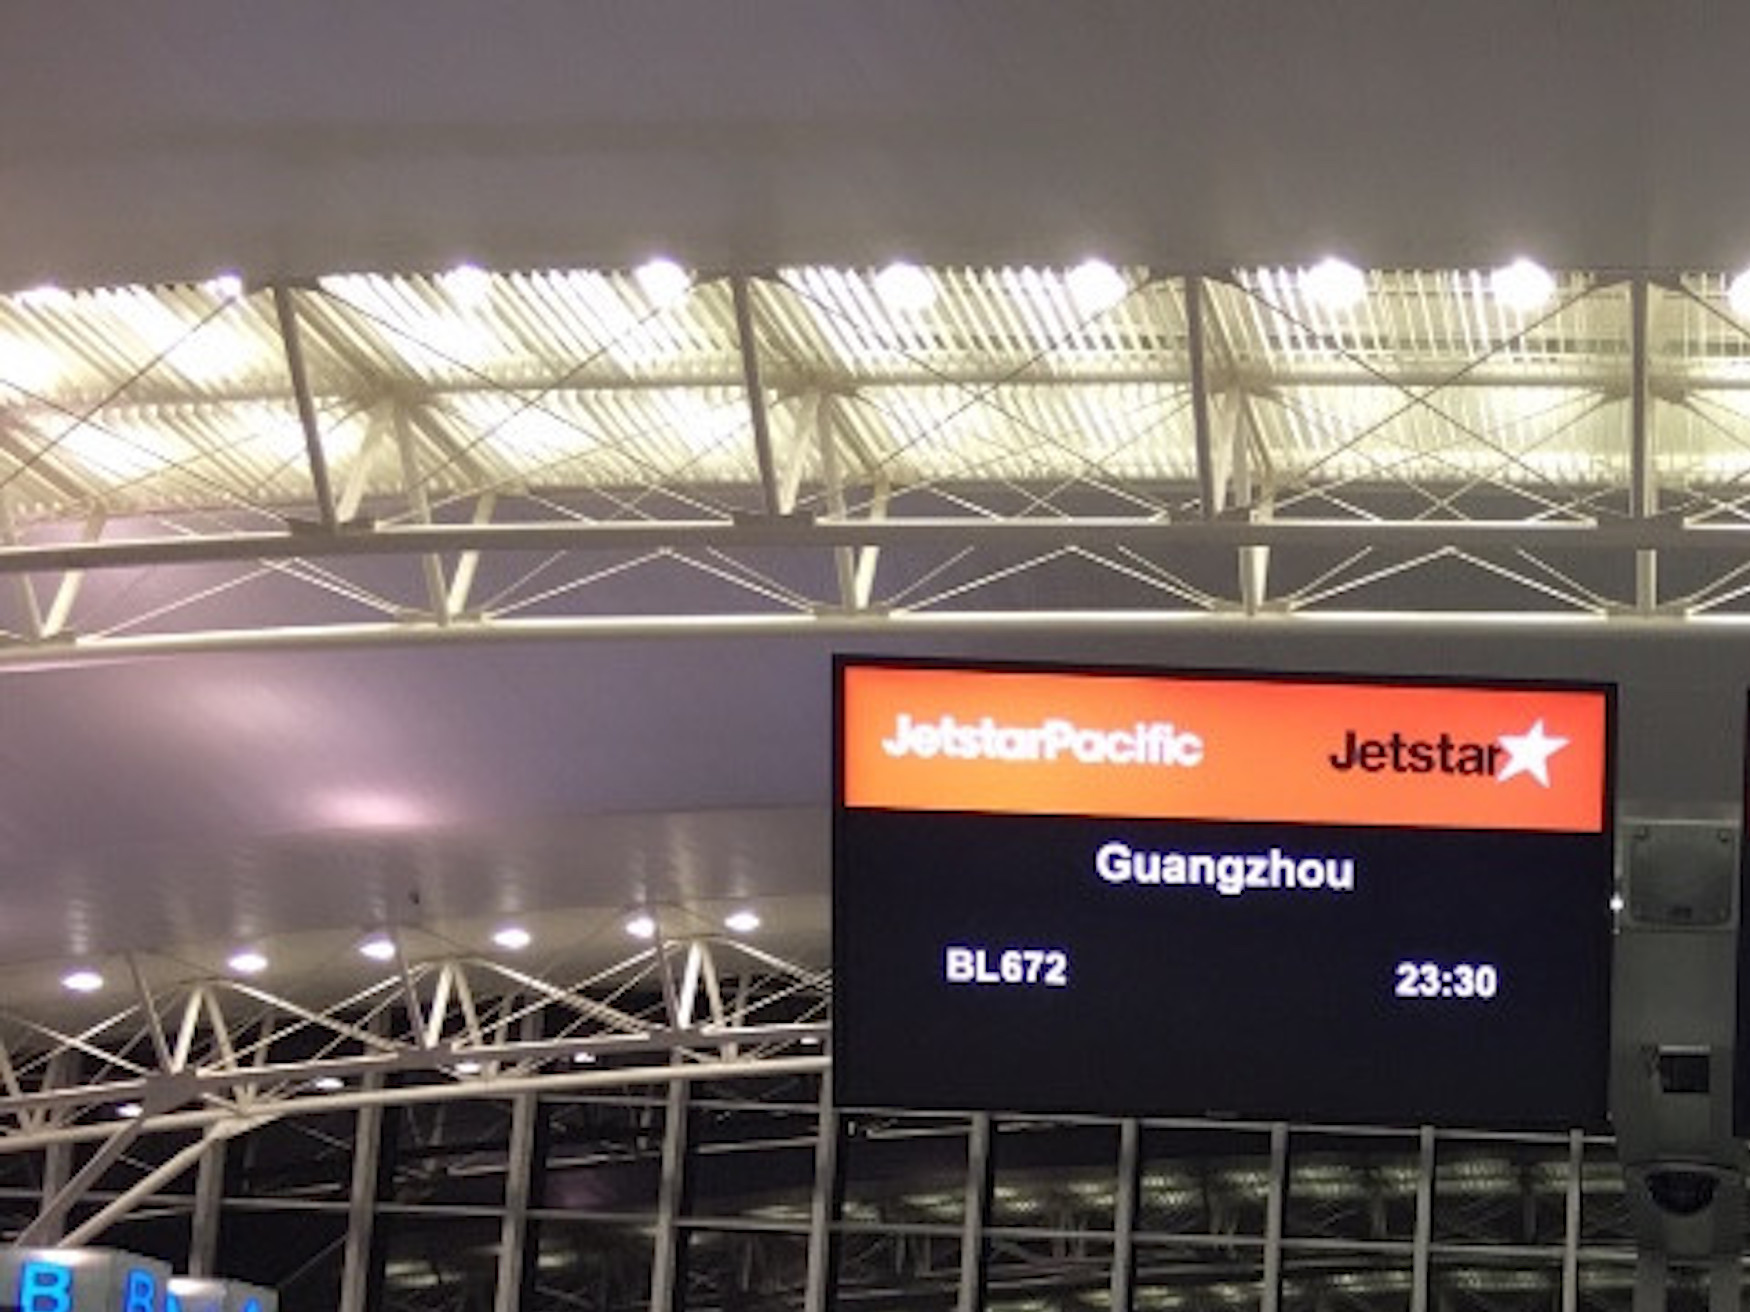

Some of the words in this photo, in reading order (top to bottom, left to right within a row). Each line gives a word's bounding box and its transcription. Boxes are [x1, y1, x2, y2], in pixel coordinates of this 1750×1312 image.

[882, 714, 1203, 767] JetstarPacific
[1330, 730, 1502, 778] Jetstar
[1096, 842, 1355, 894] Guangzhou
[945, 947, 1067, 986] BL672
[1395, 963, 1498, 998] 23:30
